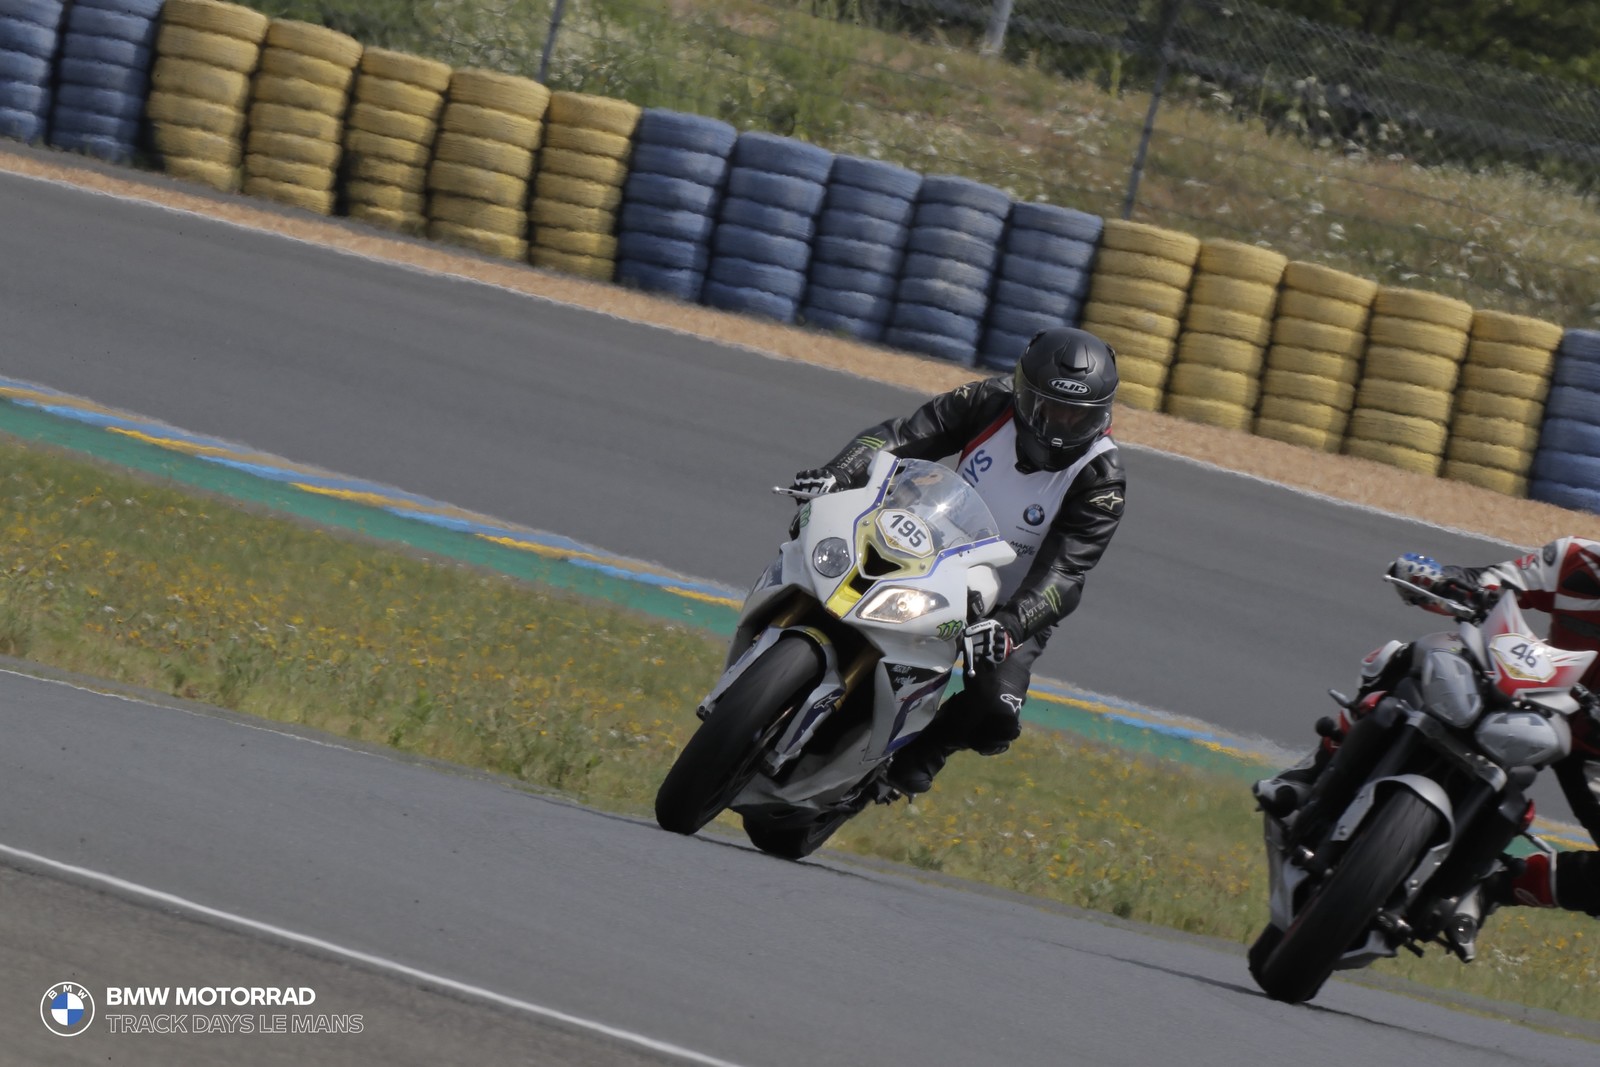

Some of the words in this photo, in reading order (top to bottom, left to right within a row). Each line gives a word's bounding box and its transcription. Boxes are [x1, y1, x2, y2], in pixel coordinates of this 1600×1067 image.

[1053, 381, 1087, 393] HJC
[890, 514, 927, 548] 195
[1010, 541, 1035, 551] MAKE
[1510, 643, 1537, 668] 46
